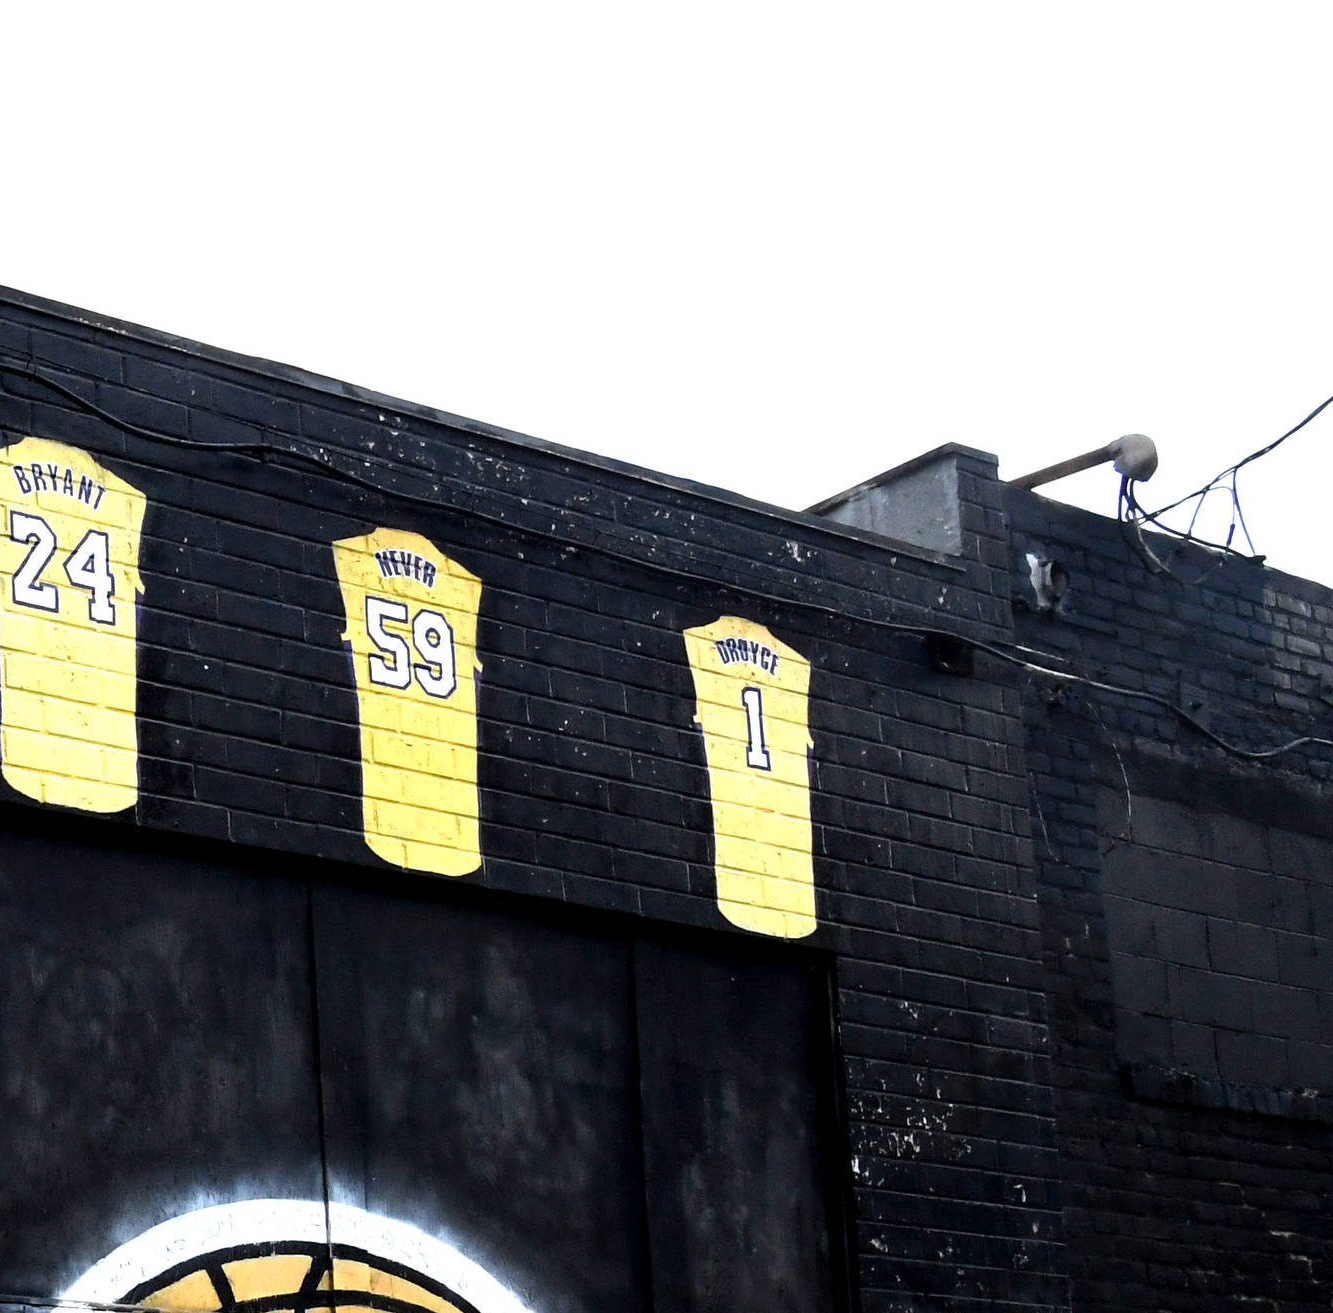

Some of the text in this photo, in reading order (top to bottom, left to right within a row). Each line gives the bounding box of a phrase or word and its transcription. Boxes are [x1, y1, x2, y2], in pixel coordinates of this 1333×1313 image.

[13, 462, 107, 511] BRYANT
[10, 510, 115, 626] 24
[374, 550, 437, 588] NEVER
[365, 595, 457, 699] 59
[741, 686, 771, 772] 1
